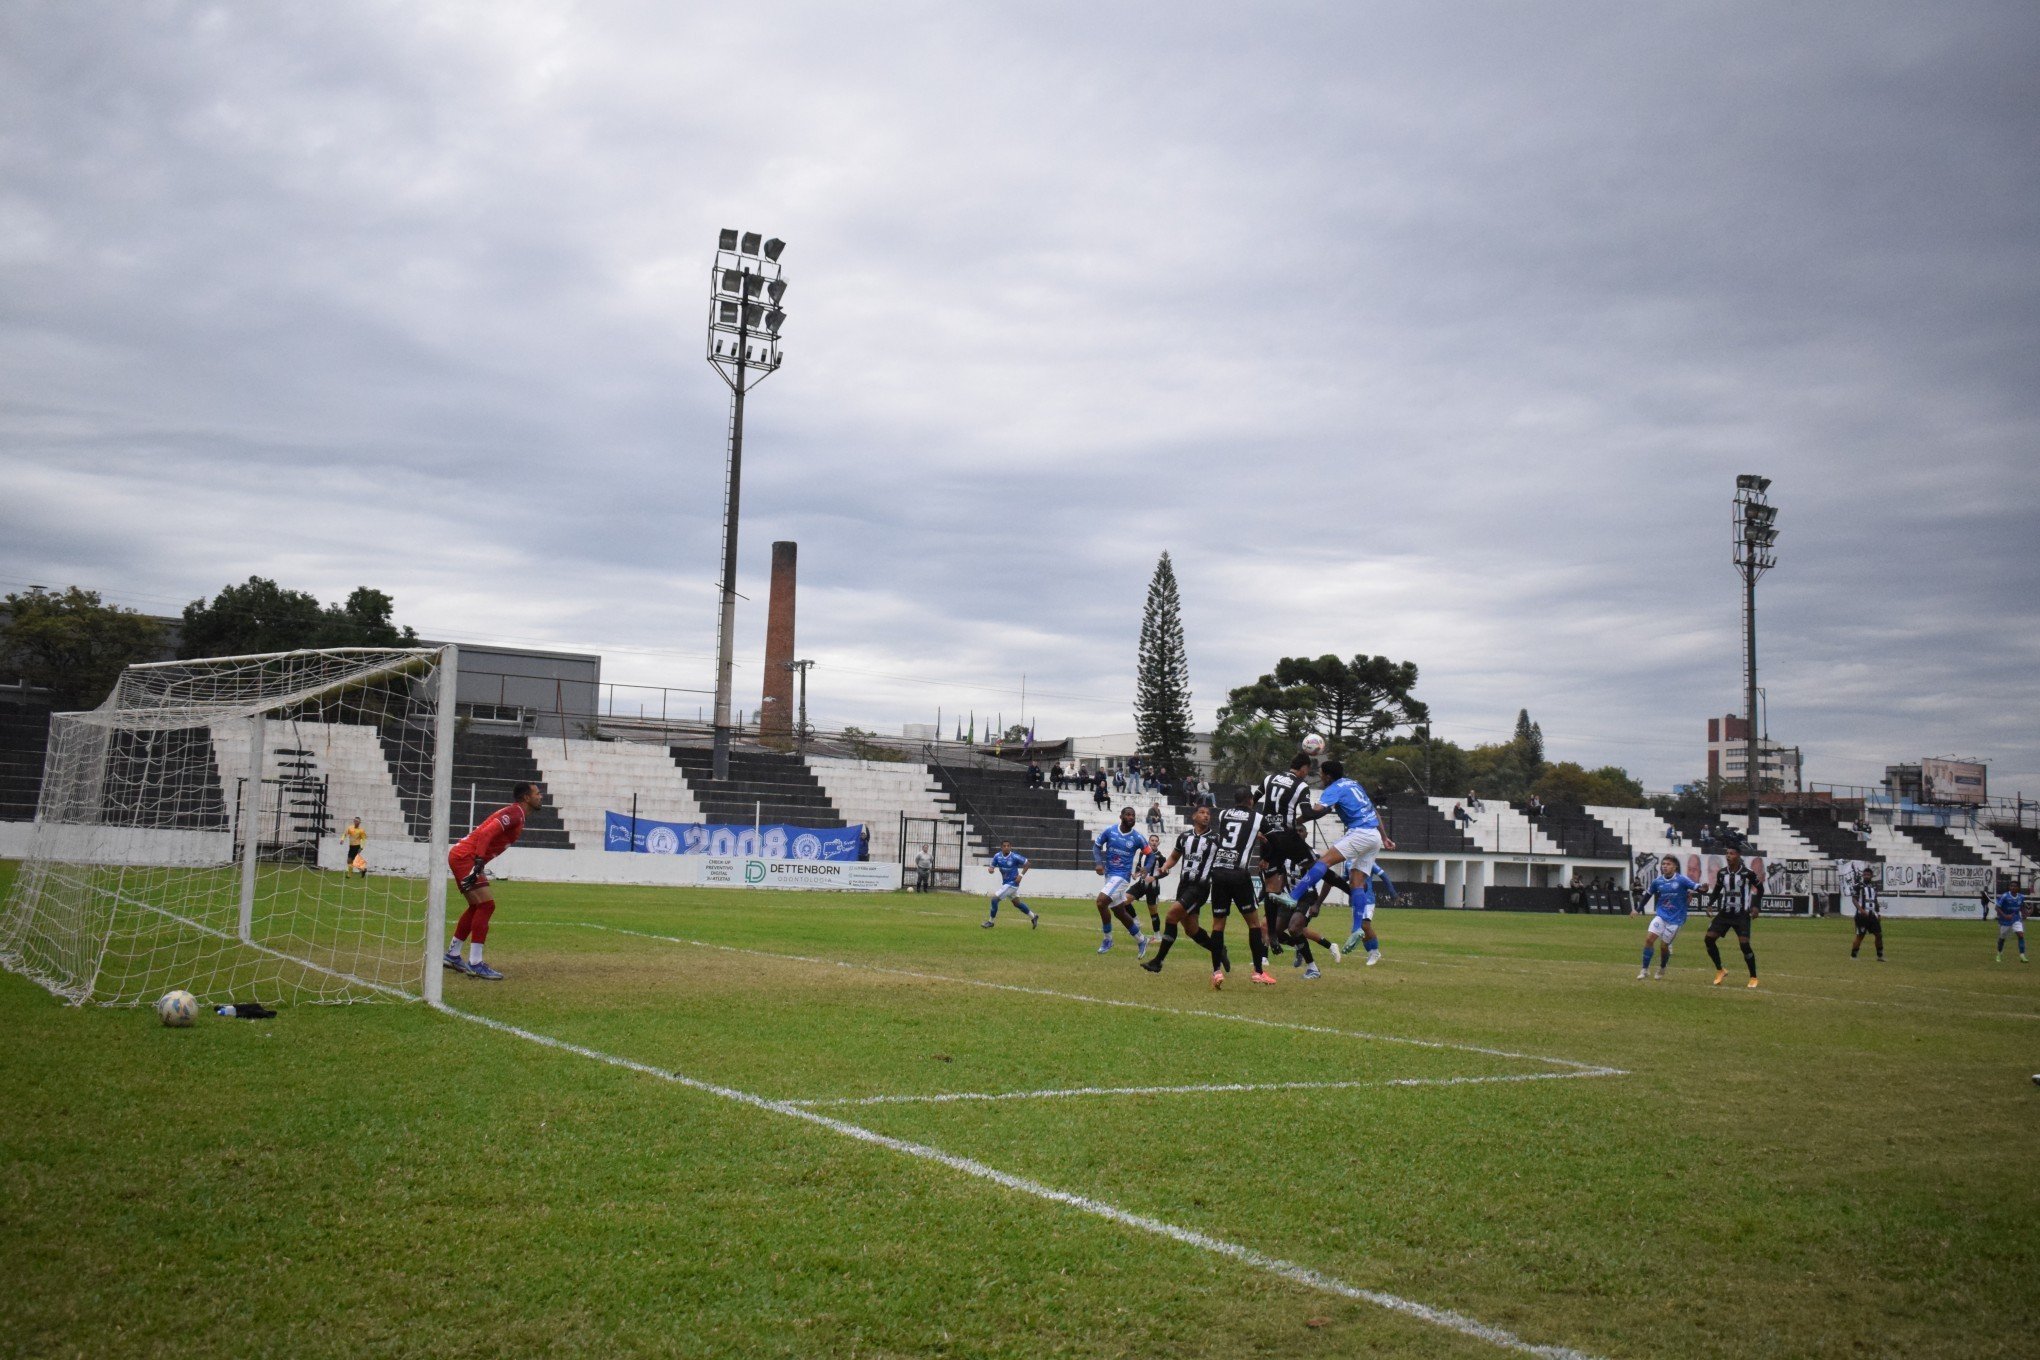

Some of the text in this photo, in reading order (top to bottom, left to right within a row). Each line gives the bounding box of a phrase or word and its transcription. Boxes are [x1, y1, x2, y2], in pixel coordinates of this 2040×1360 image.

[1270, 785, 1285, 813] 4
[683, 826, 788, 858] 2008
[1221, 821, 1242, 848] 3
[770, 863, 841, 875] DETTENBORN
[1792, 861, 1809, 871] GALO
[1922, 864, 1931, 875] DE
